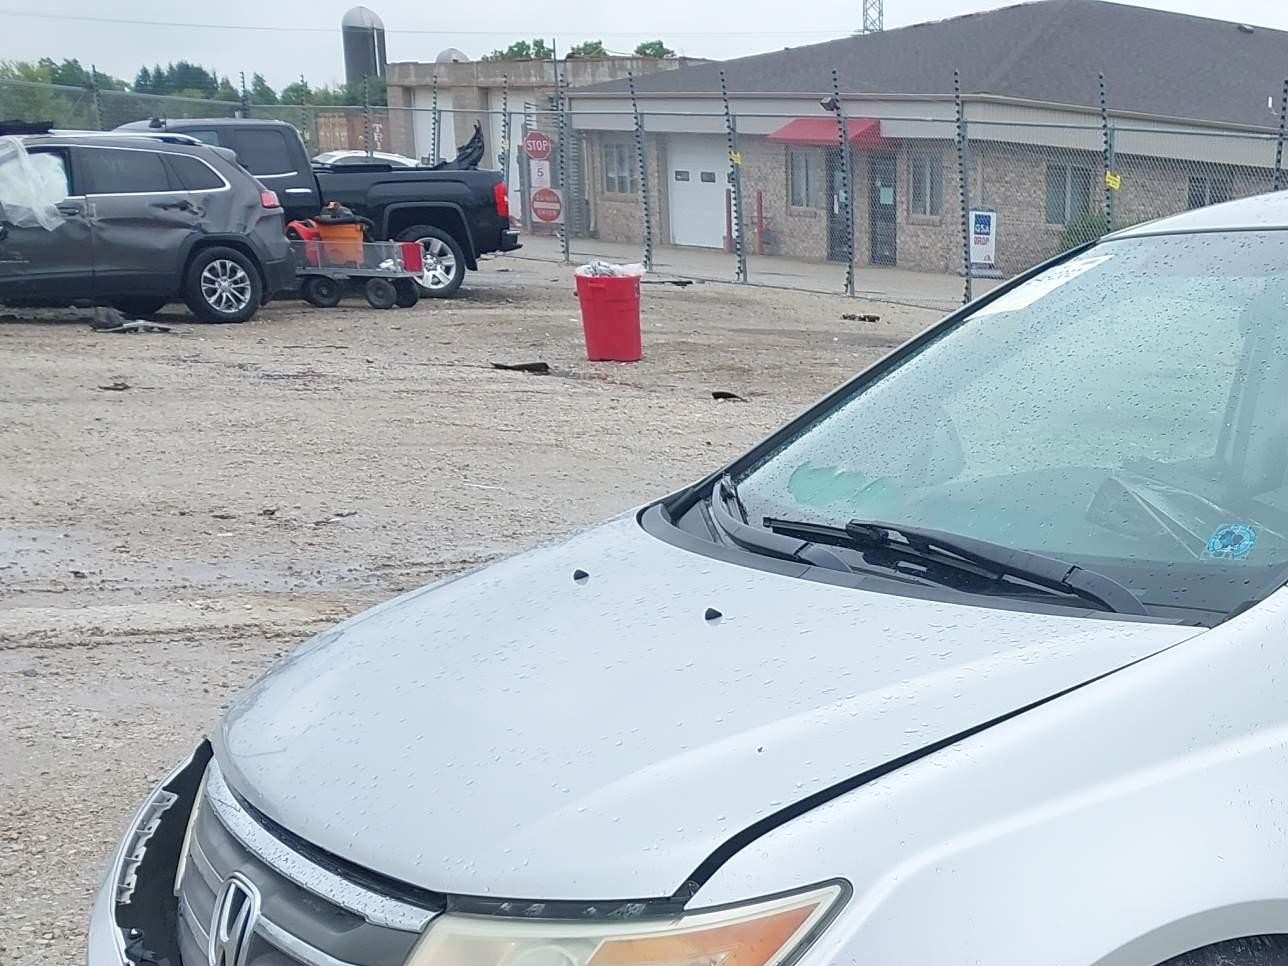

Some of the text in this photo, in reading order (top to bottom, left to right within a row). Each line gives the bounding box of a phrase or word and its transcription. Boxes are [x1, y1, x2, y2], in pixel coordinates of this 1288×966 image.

[526, 140, 549, 152] STOP
[537, 167, 544, 177] 5
[975, 224, 990, 234] GSA
